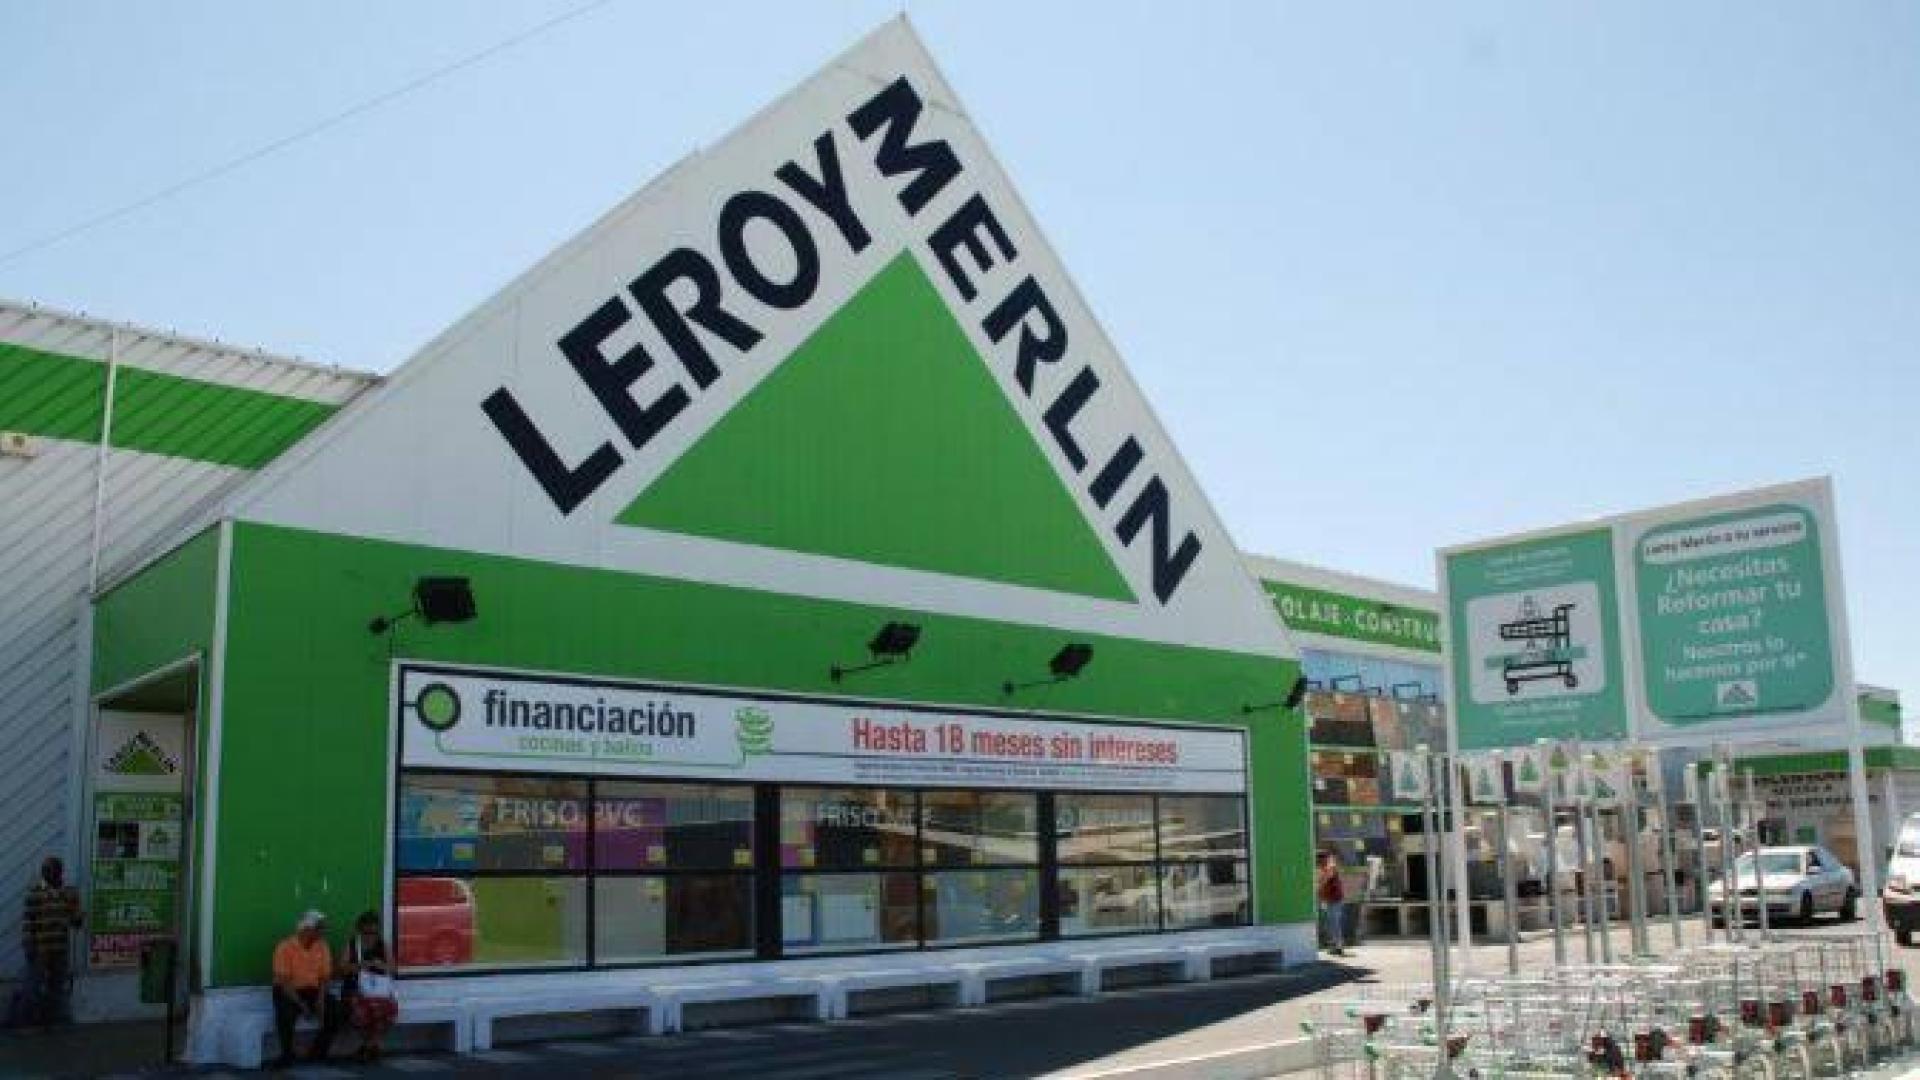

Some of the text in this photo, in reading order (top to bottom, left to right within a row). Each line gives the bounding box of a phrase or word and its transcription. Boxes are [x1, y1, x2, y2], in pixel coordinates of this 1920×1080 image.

[480, 130, 872, 516] LEROY
[846, 75, 1202, 606] MERLIN
[1665, 556, 1789, 593] ¿Necesitas
[1270, 593, 1340, 626] OLAJE
[1657, 580, 1801, 614] Reformar tu
[483, 689, 696, 739] financiación
[852, 717, 1177, 764] Hasta 18 meses sin intereses
[495, 798, 580, 826] FRISO
